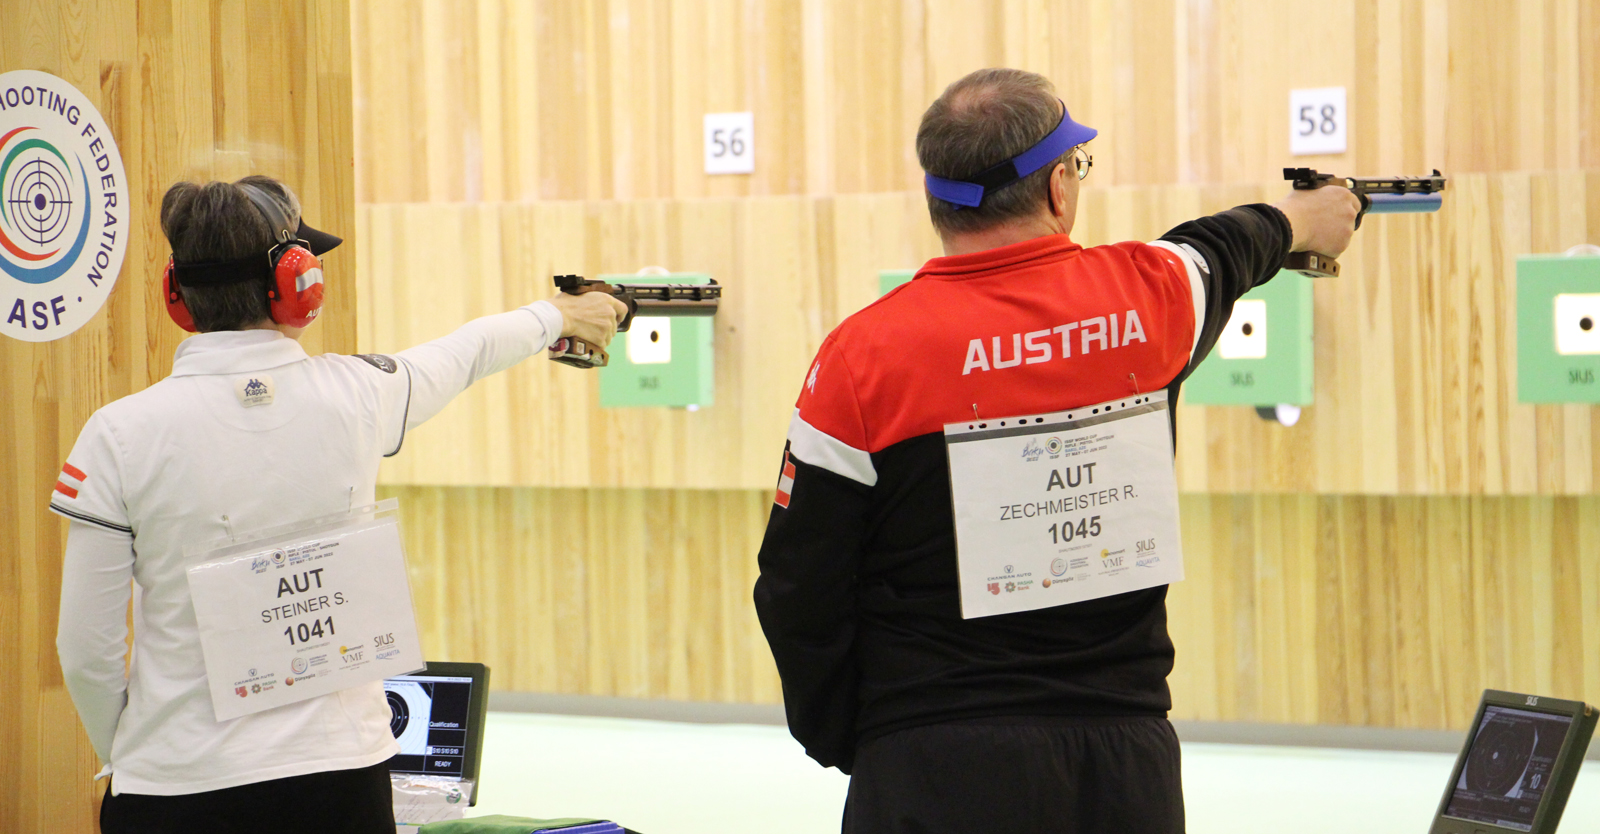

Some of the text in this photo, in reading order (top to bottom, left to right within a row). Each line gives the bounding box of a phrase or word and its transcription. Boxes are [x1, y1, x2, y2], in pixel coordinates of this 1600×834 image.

[1299, 104, 1336, 136] 58
[712, 128, 745, 158] 56
[81, 123, 118, 287] FEDERATION
[7, 295, 66, 330] ASF
[962, 309, 1147, 376] AUSTRIA
[245, 388, 268, 397] Kappa
[1046, 462, 1096, 491] AUT
[1000, 485, 1138, 521] ZECHMEISTER R.
[1048, 515, 1101, 544] 1045
[1135, 538, 1156, 553] SIUS
[1102, 556, 1124, 568] VMF
[277, 568, 323, 598] AUT
[261, 592, 349, 623] STEINER S.
[284, 616, 335, 646] 1041
[373, 632, 395, 647] SIUS
[342, 651, 364, 663] VMF
[1530, 773, 1541, 789] 10
